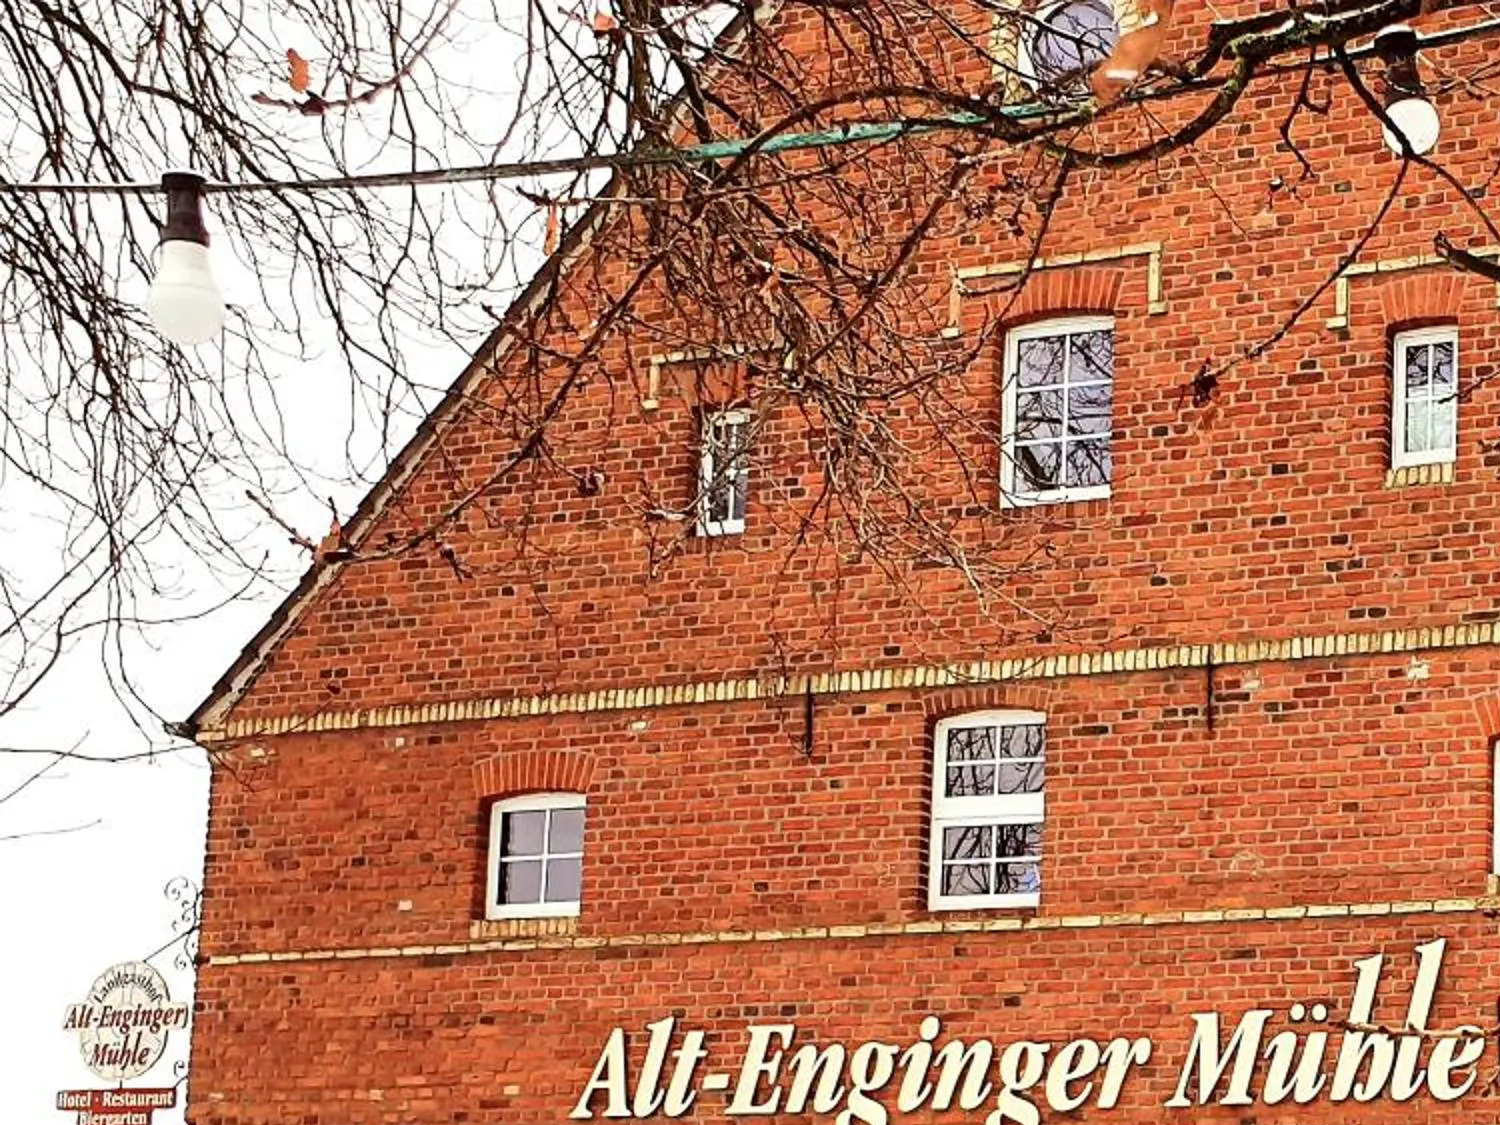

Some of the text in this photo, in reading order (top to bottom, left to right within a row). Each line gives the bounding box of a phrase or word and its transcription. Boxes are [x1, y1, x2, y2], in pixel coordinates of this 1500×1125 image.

[93, 971, 163, 1003] Landgasthof
[64, 1004, 184, 1034] Alt-Enginger
[1163, 937, 1487, 1108] Mühle
[88, 1029, 150, 1071] Mühle
[58, 1090, 174, 1108] Hotel Restaurant
